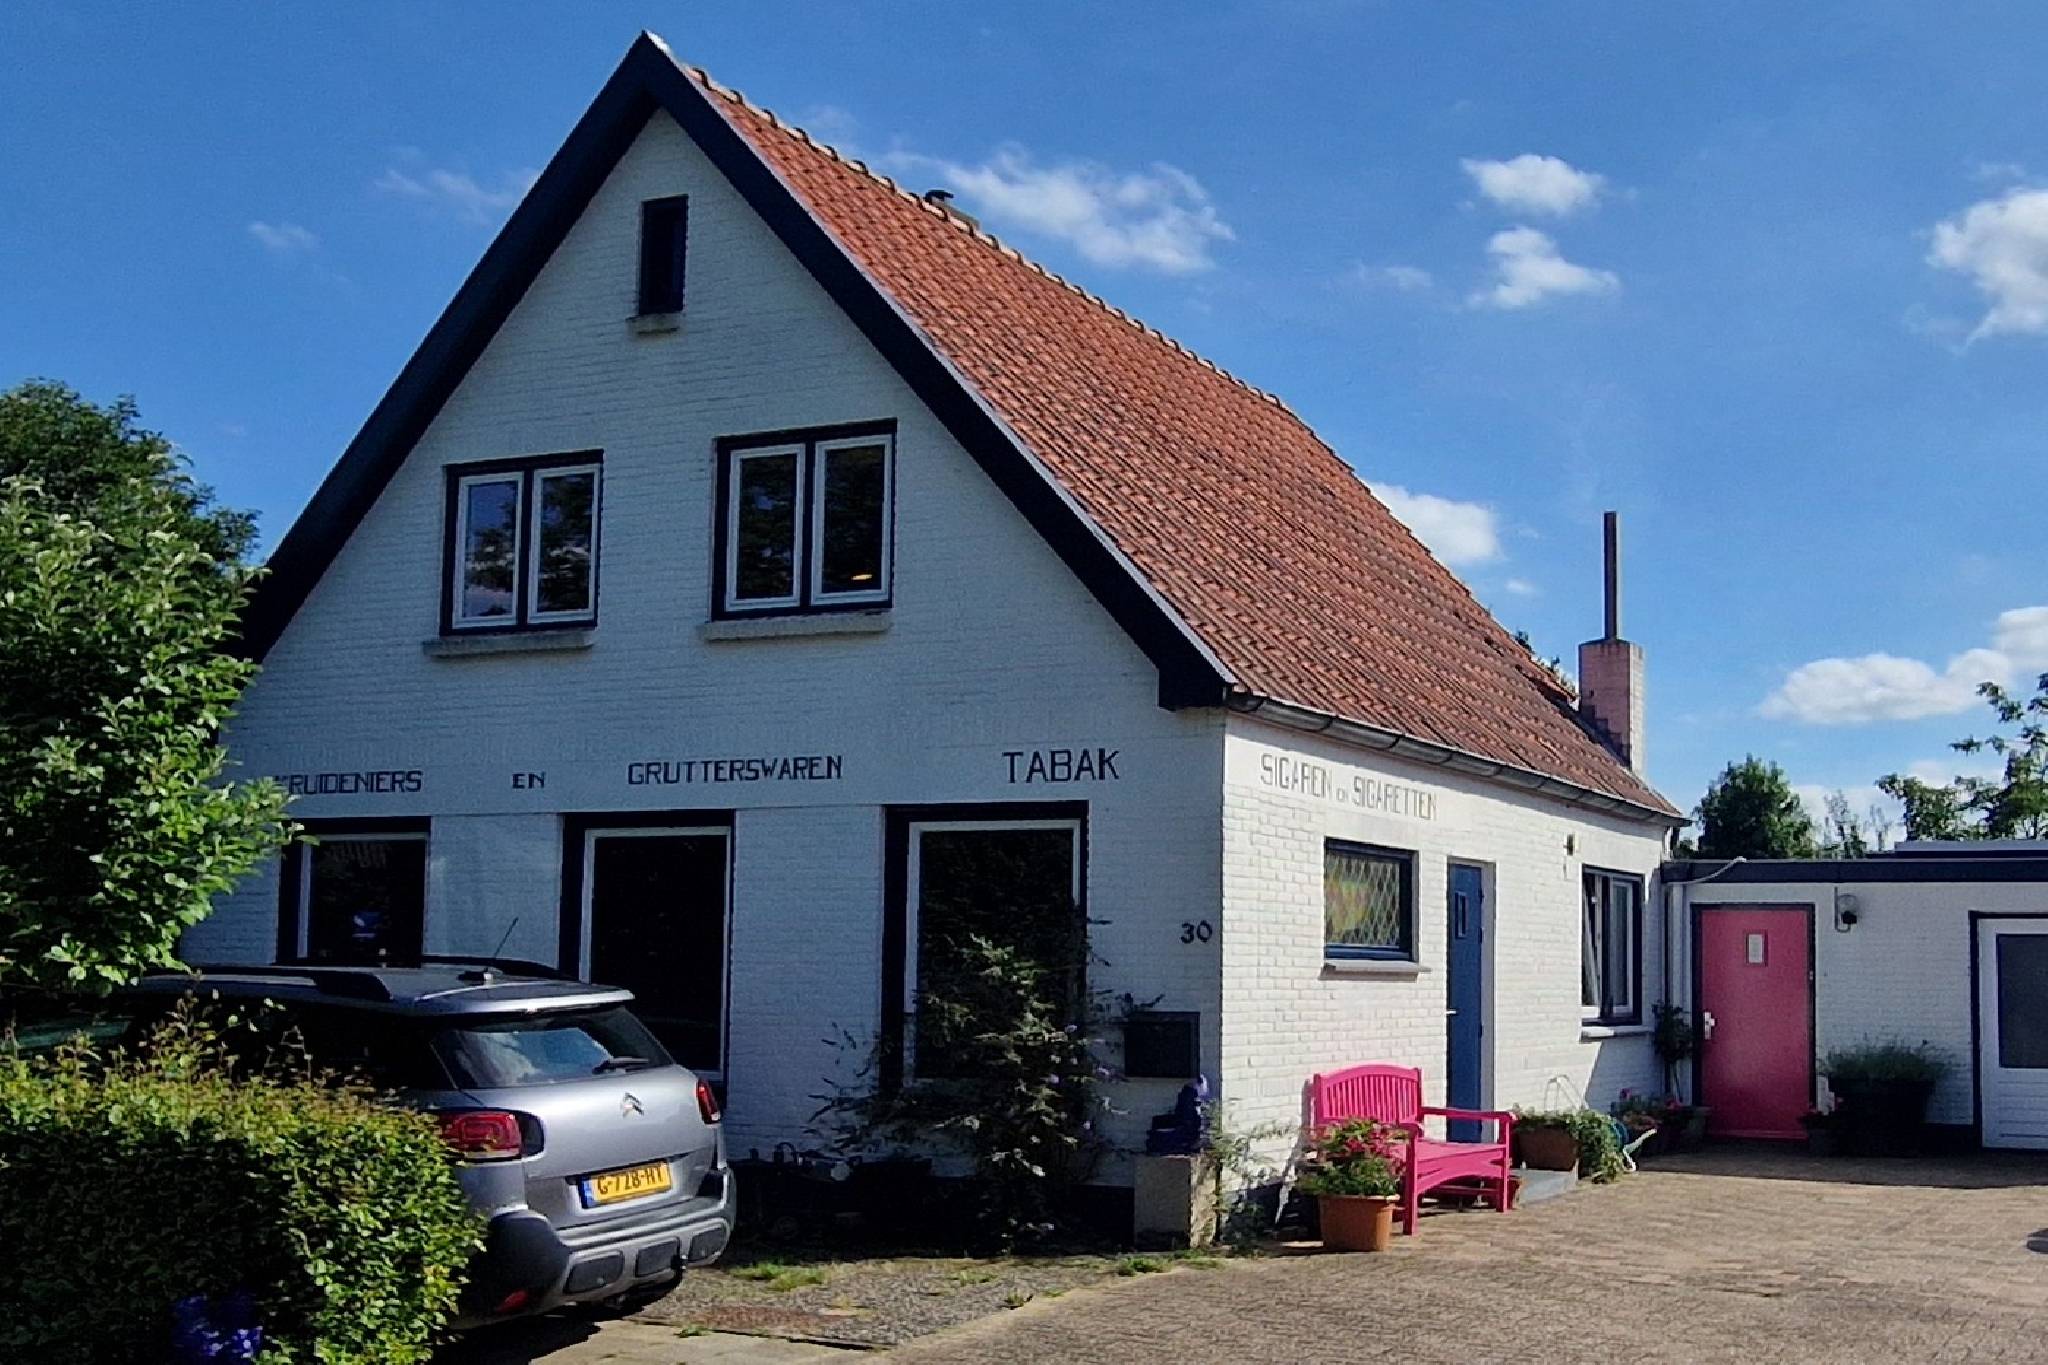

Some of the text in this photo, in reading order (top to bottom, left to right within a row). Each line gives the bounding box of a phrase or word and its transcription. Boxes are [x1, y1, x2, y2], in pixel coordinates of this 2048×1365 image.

[512, 772, 545, 789] EN
[628, 755, 842, 784] GRUTTERSWAREN
[1002, 748, 1120, 783] TABAK
[1261, 752, 1333, 800] SIGAREN
[1353, 775, 1437, 821] SIGARETTEN
[1181, 920, 1212, 943] 30
